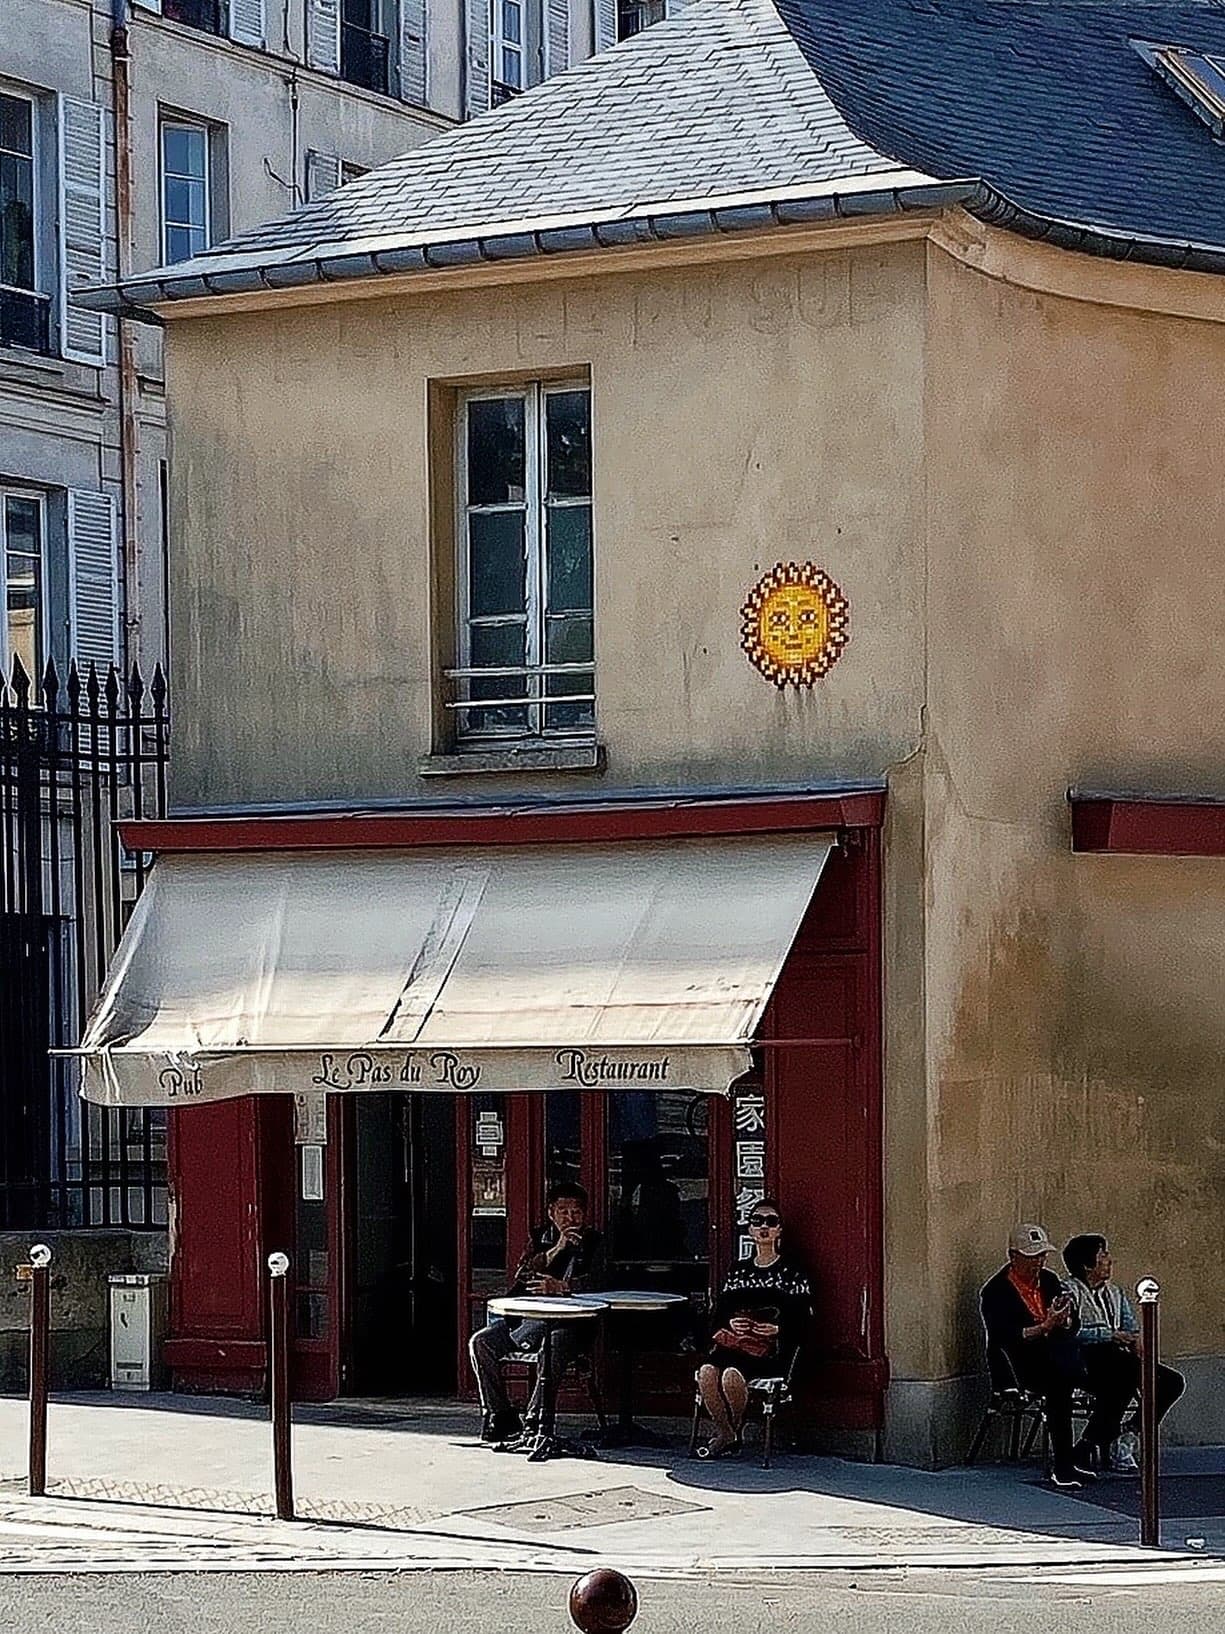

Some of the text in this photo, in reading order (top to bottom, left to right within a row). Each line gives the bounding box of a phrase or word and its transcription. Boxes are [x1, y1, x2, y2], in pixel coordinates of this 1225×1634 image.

[159, 1048, 670, 1097] Pub Le Pas du Roy Restaurant
